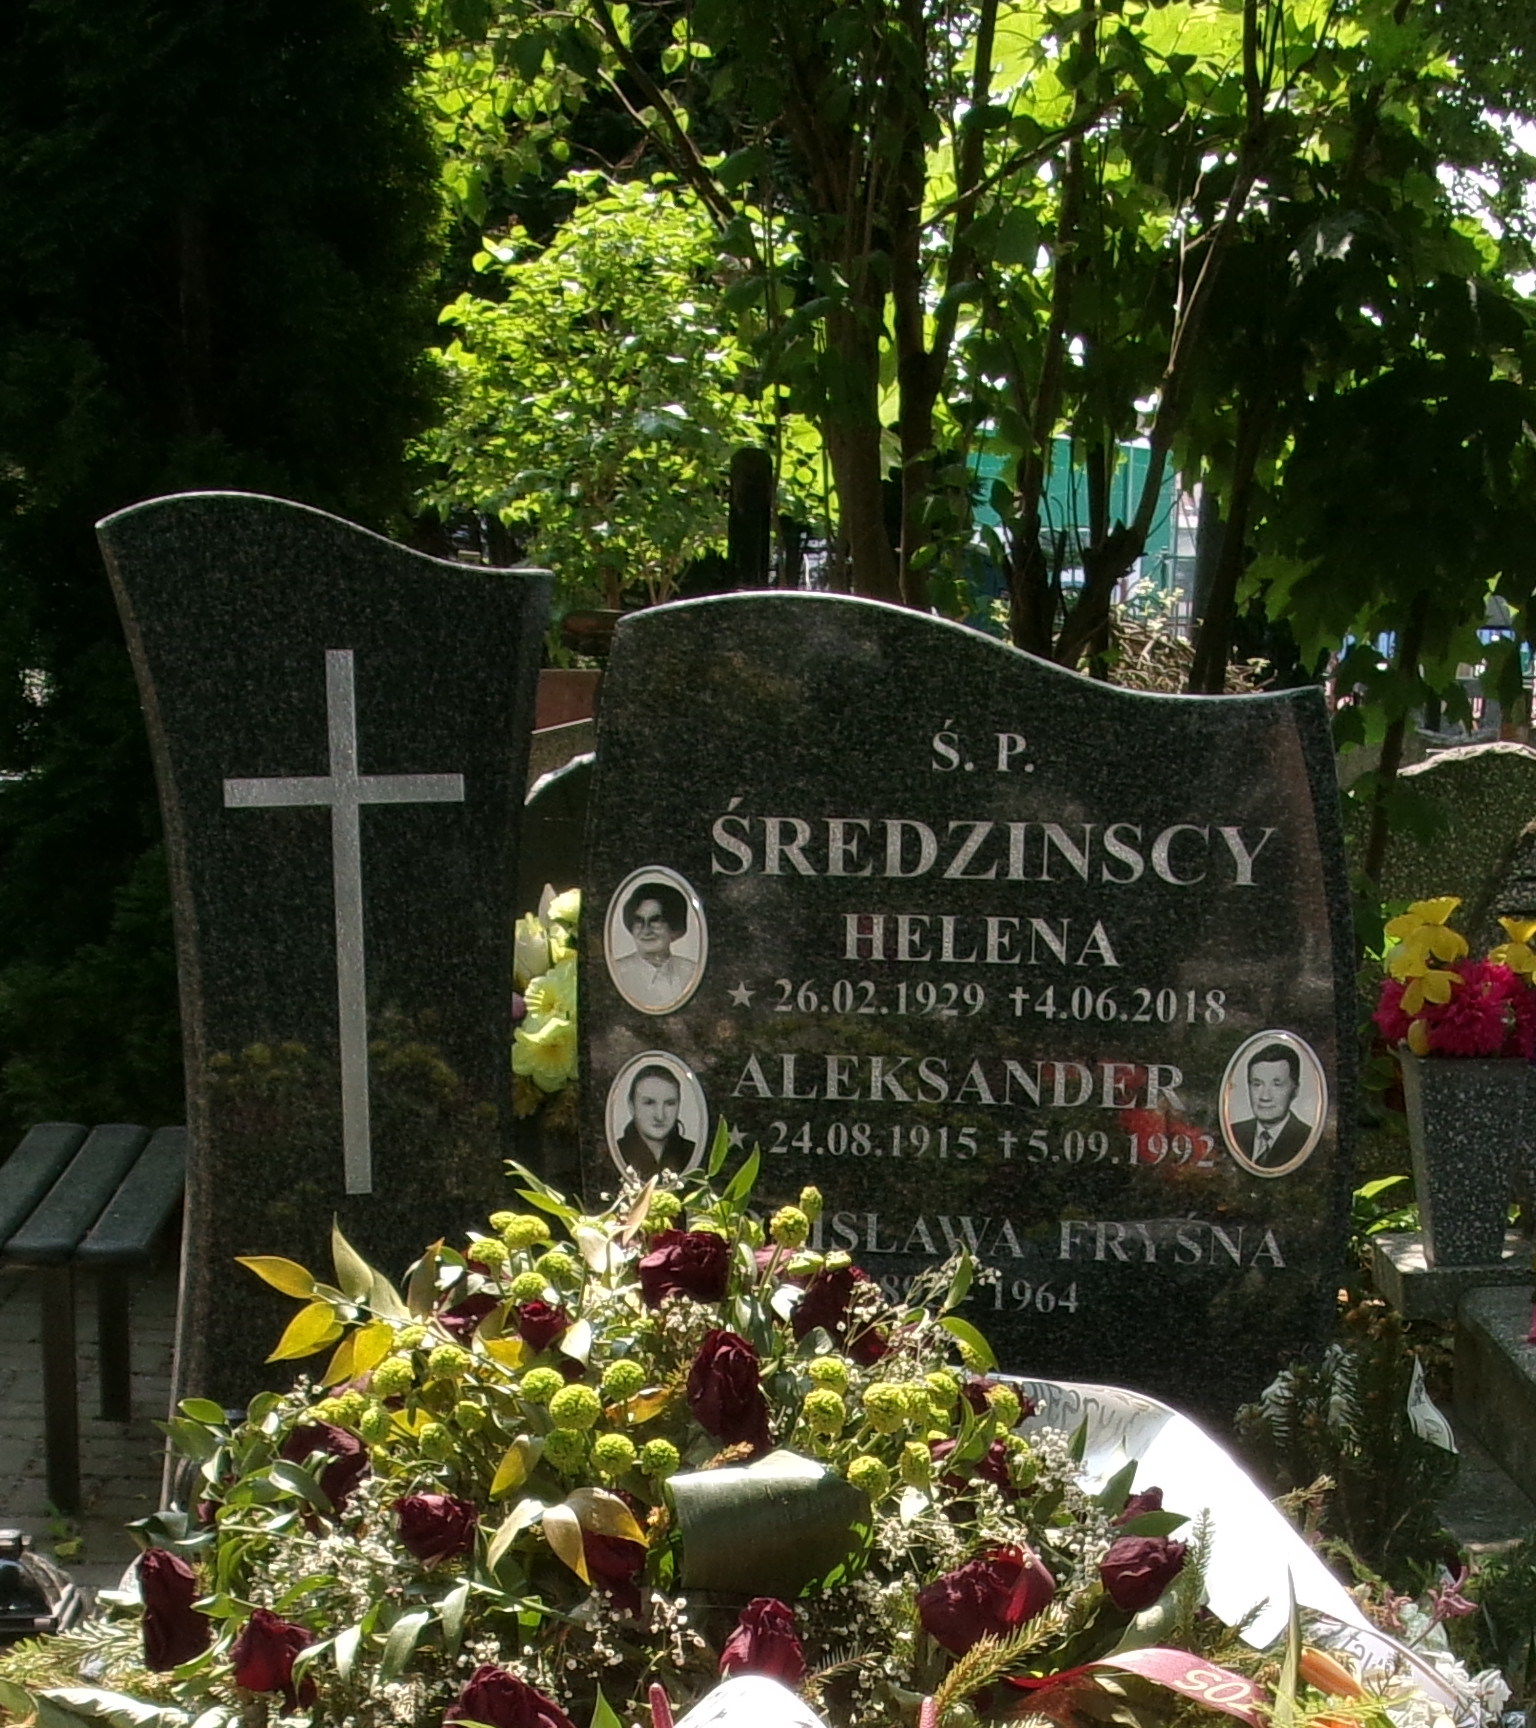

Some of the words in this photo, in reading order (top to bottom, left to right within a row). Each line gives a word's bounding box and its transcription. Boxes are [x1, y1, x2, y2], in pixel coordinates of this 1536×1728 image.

[931, 719, 974, 773] Ś.
[995, 732, 1035, 774] P.
[710, 797, 1278, 887] ŚREDZINSCY
[842, 911, 1121, 968] HELENA
[773, 979, 985, 1016] 26.02.1929
[731, 1053, 1188, 1112] ALEKSANDER
[768, 1120, 979, 1158] 24.08.1915
[1026, 1129, 1218, 1168] 5.09.1992
[1056, 1212, 1288, 1270] FRYŚNA
[989, 1276, 1080, 1314] 1964
